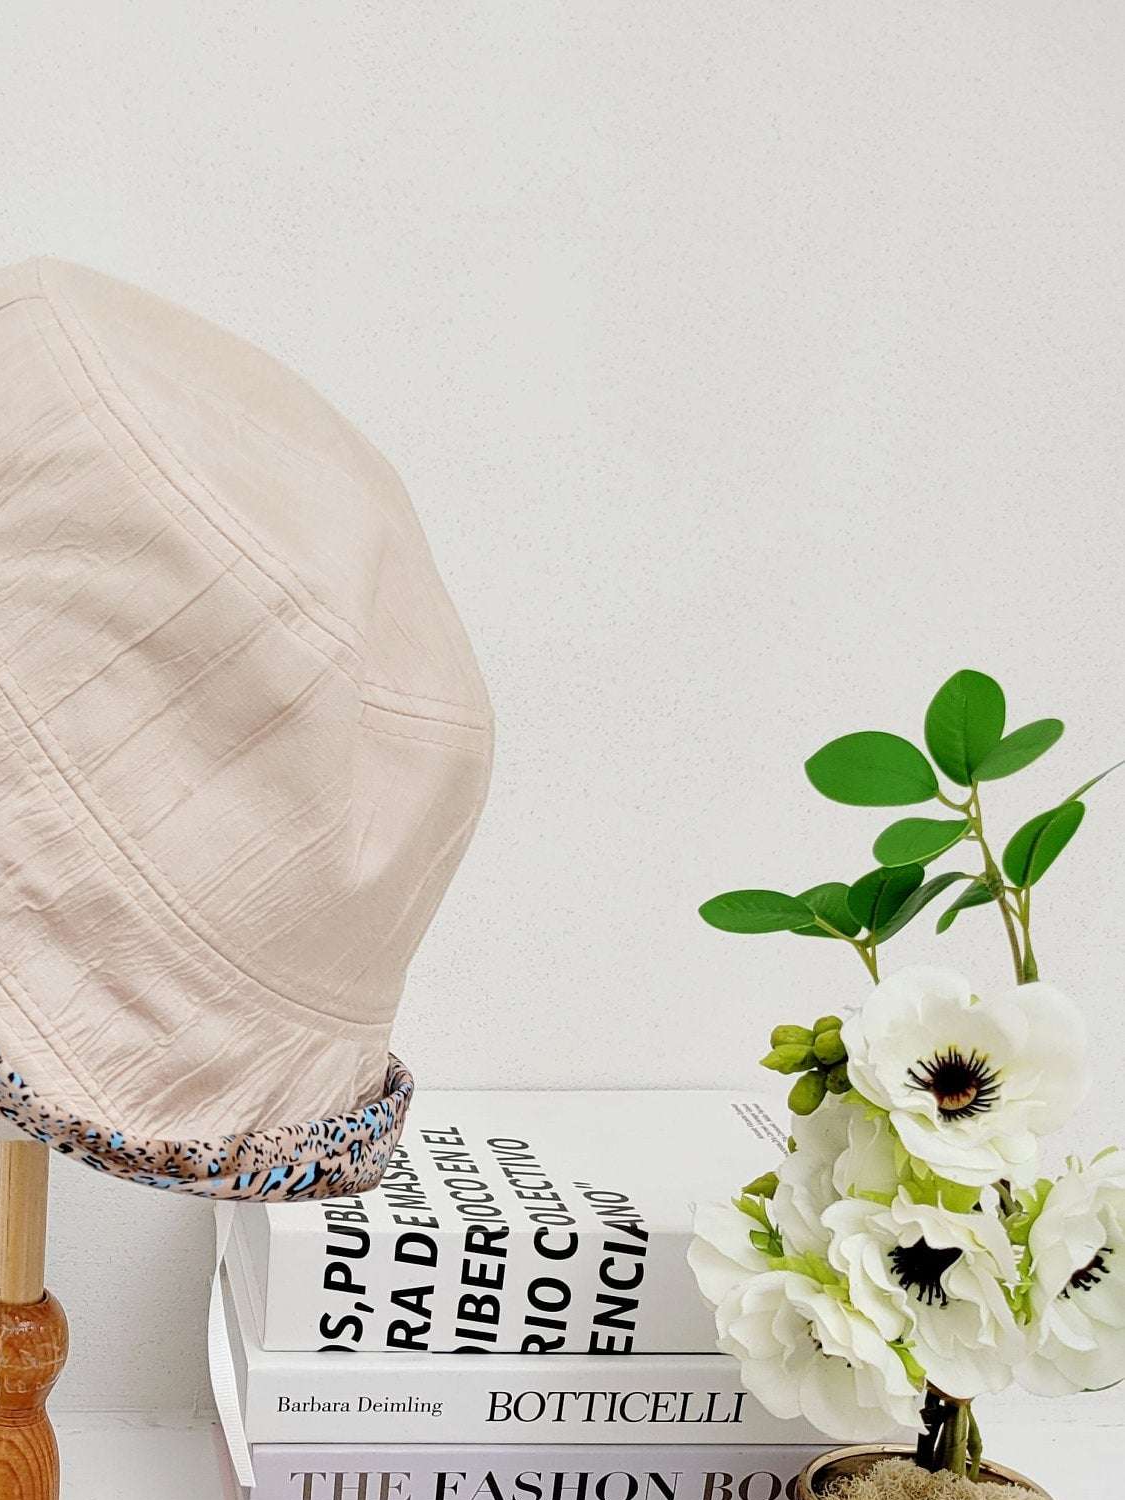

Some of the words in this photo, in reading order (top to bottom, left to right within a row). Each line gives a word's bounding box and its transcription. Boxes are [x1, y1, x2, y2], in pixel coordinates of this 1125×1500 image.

[420, 1126, 465, 1146] EL
[429, 1150, 480, 1174] EN
[381, 1144, 432, 1211] MASA
[487, 1138, 578, 1260] COLECTIVO
[393, 1215, 439, 1268] DE
[444, 1178, 509, 1353] IBERIOCO
[277, 1396, 350, 1413] Barbara
[357, 1396, 443, 1417] Deimling
[484, 1391, 748, 1423] BOTTICELLI
